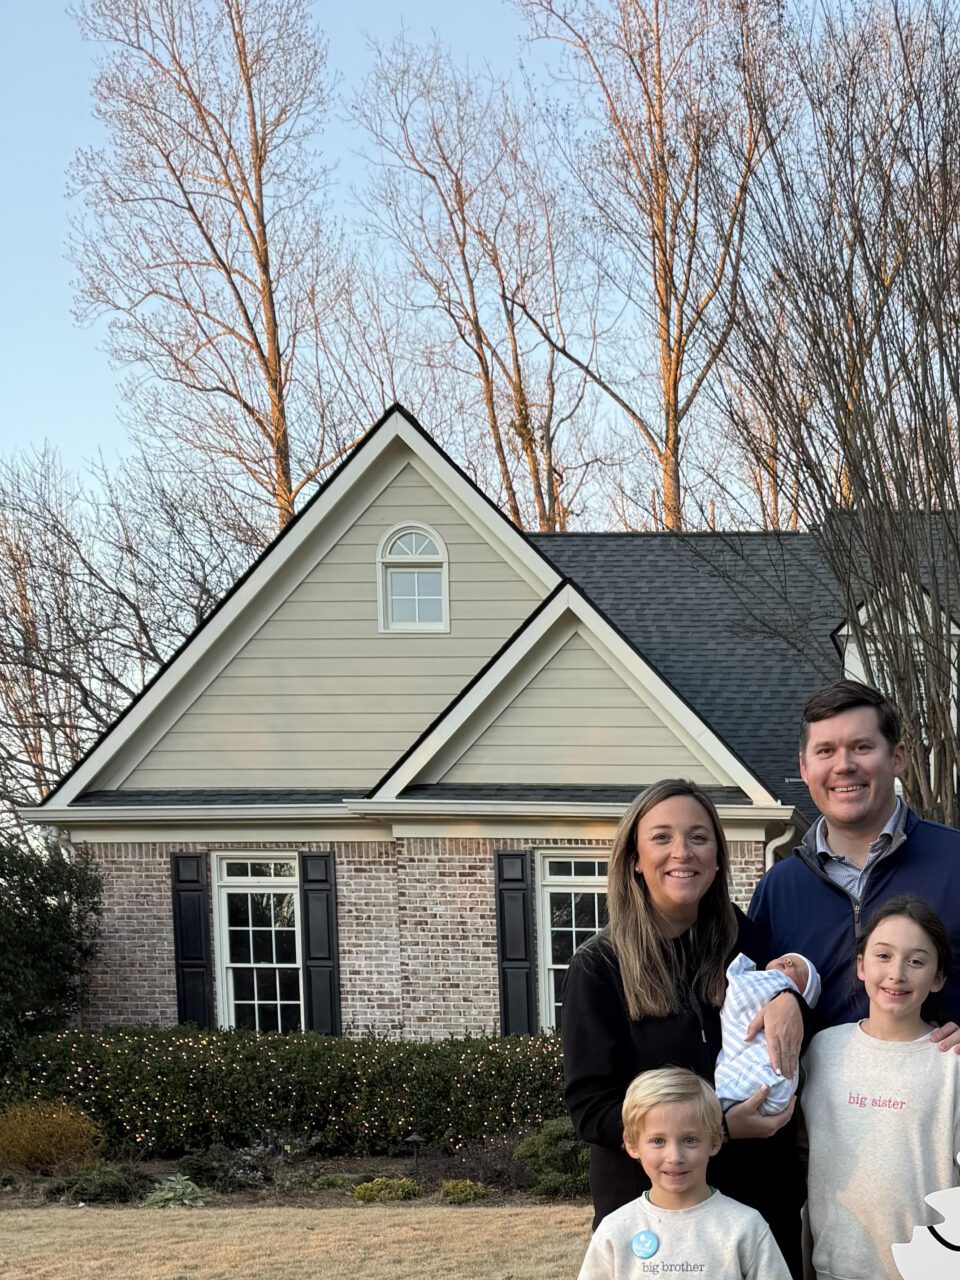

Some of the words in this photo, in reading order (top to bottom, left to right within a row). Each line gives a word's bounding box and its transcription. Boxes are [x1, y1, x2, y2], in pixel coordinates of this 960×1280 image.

[847, 1092, 868, 1108] big
[871, 1096, 907, 1110] sister
[642, 1261, 660, 1274] big
[662, 1261, 705, 1273] brother
